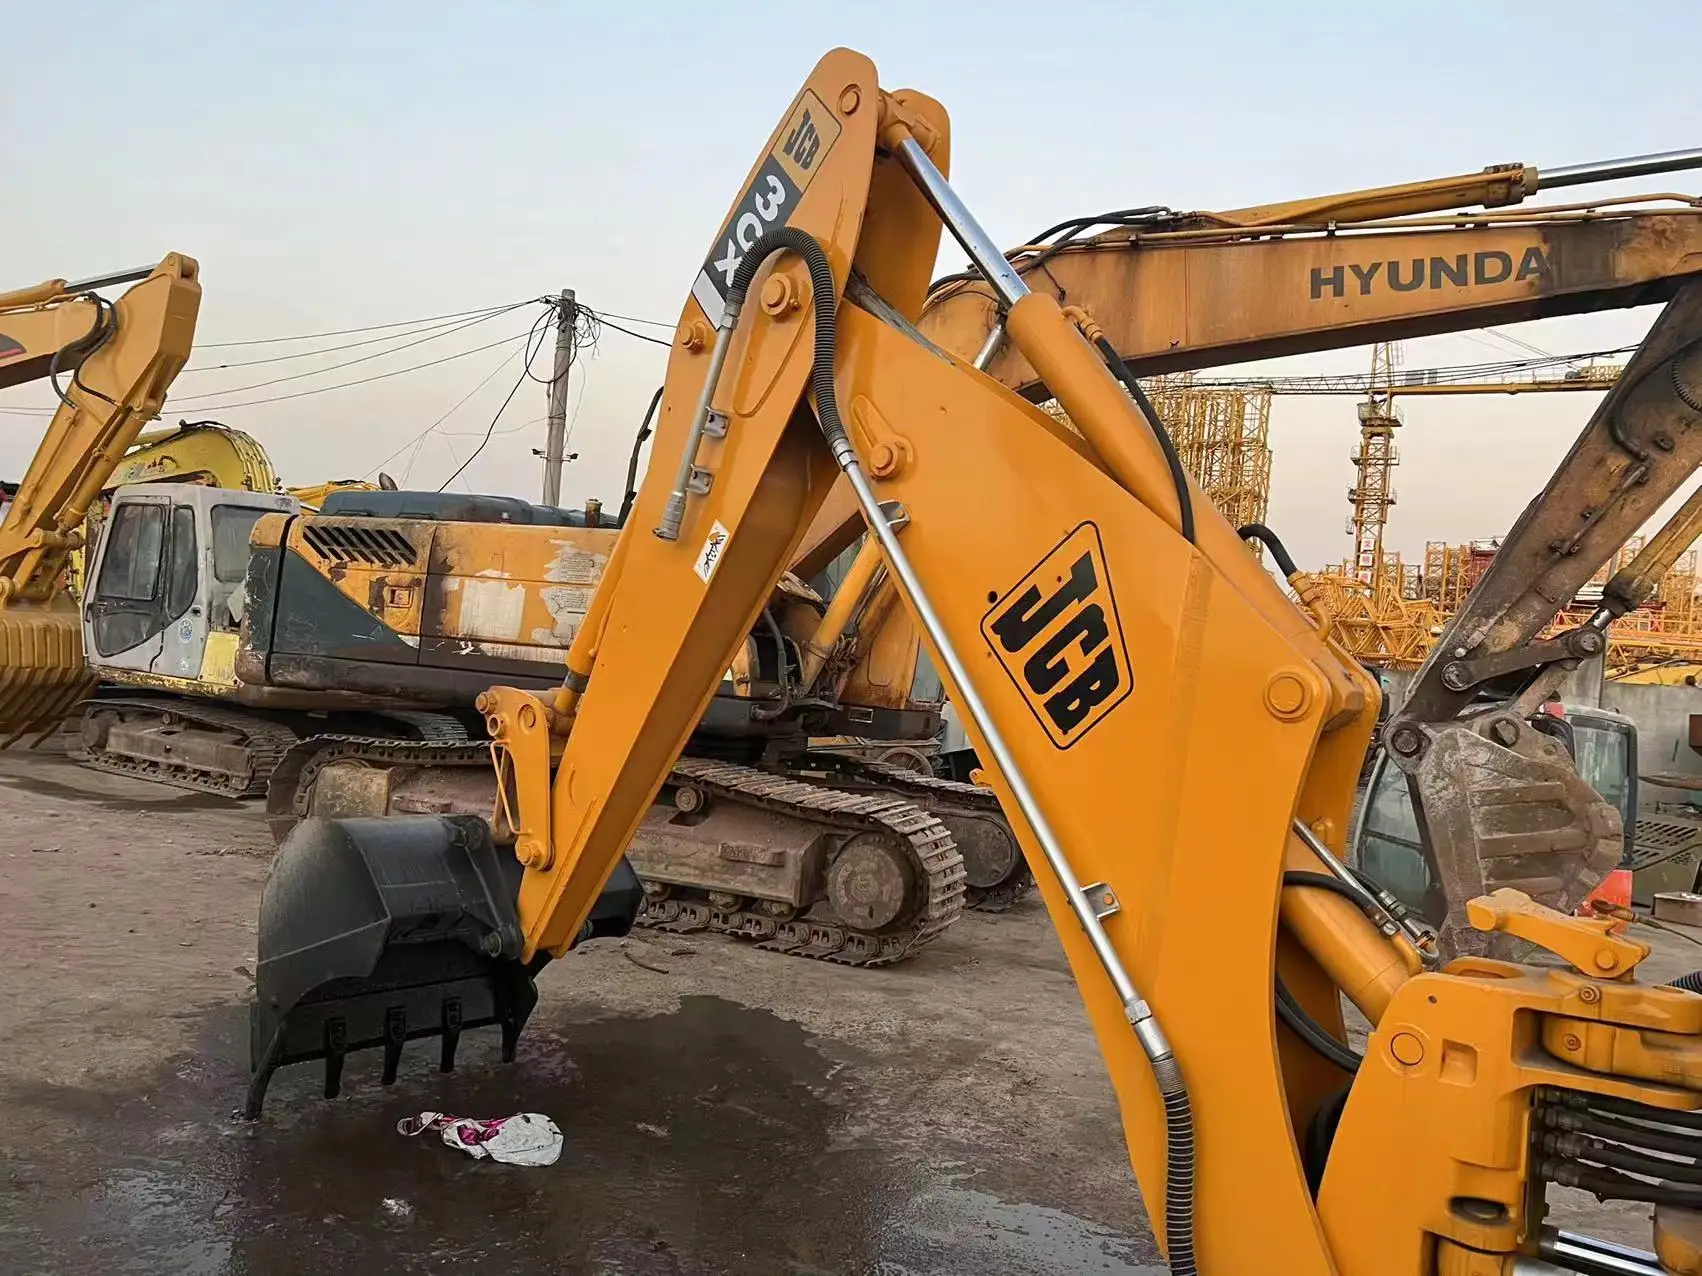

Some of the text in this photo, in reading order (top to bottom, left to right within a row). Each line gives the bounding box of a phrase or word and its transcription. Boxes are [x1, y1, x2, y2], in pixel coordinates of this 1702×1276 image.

[782, 108, 820, 170] JCB
[714, 174, 786, 288] 3CX
[1310, 246, 1551, 299] HYUNDA
[990, 550, 1119, 731] JCB
